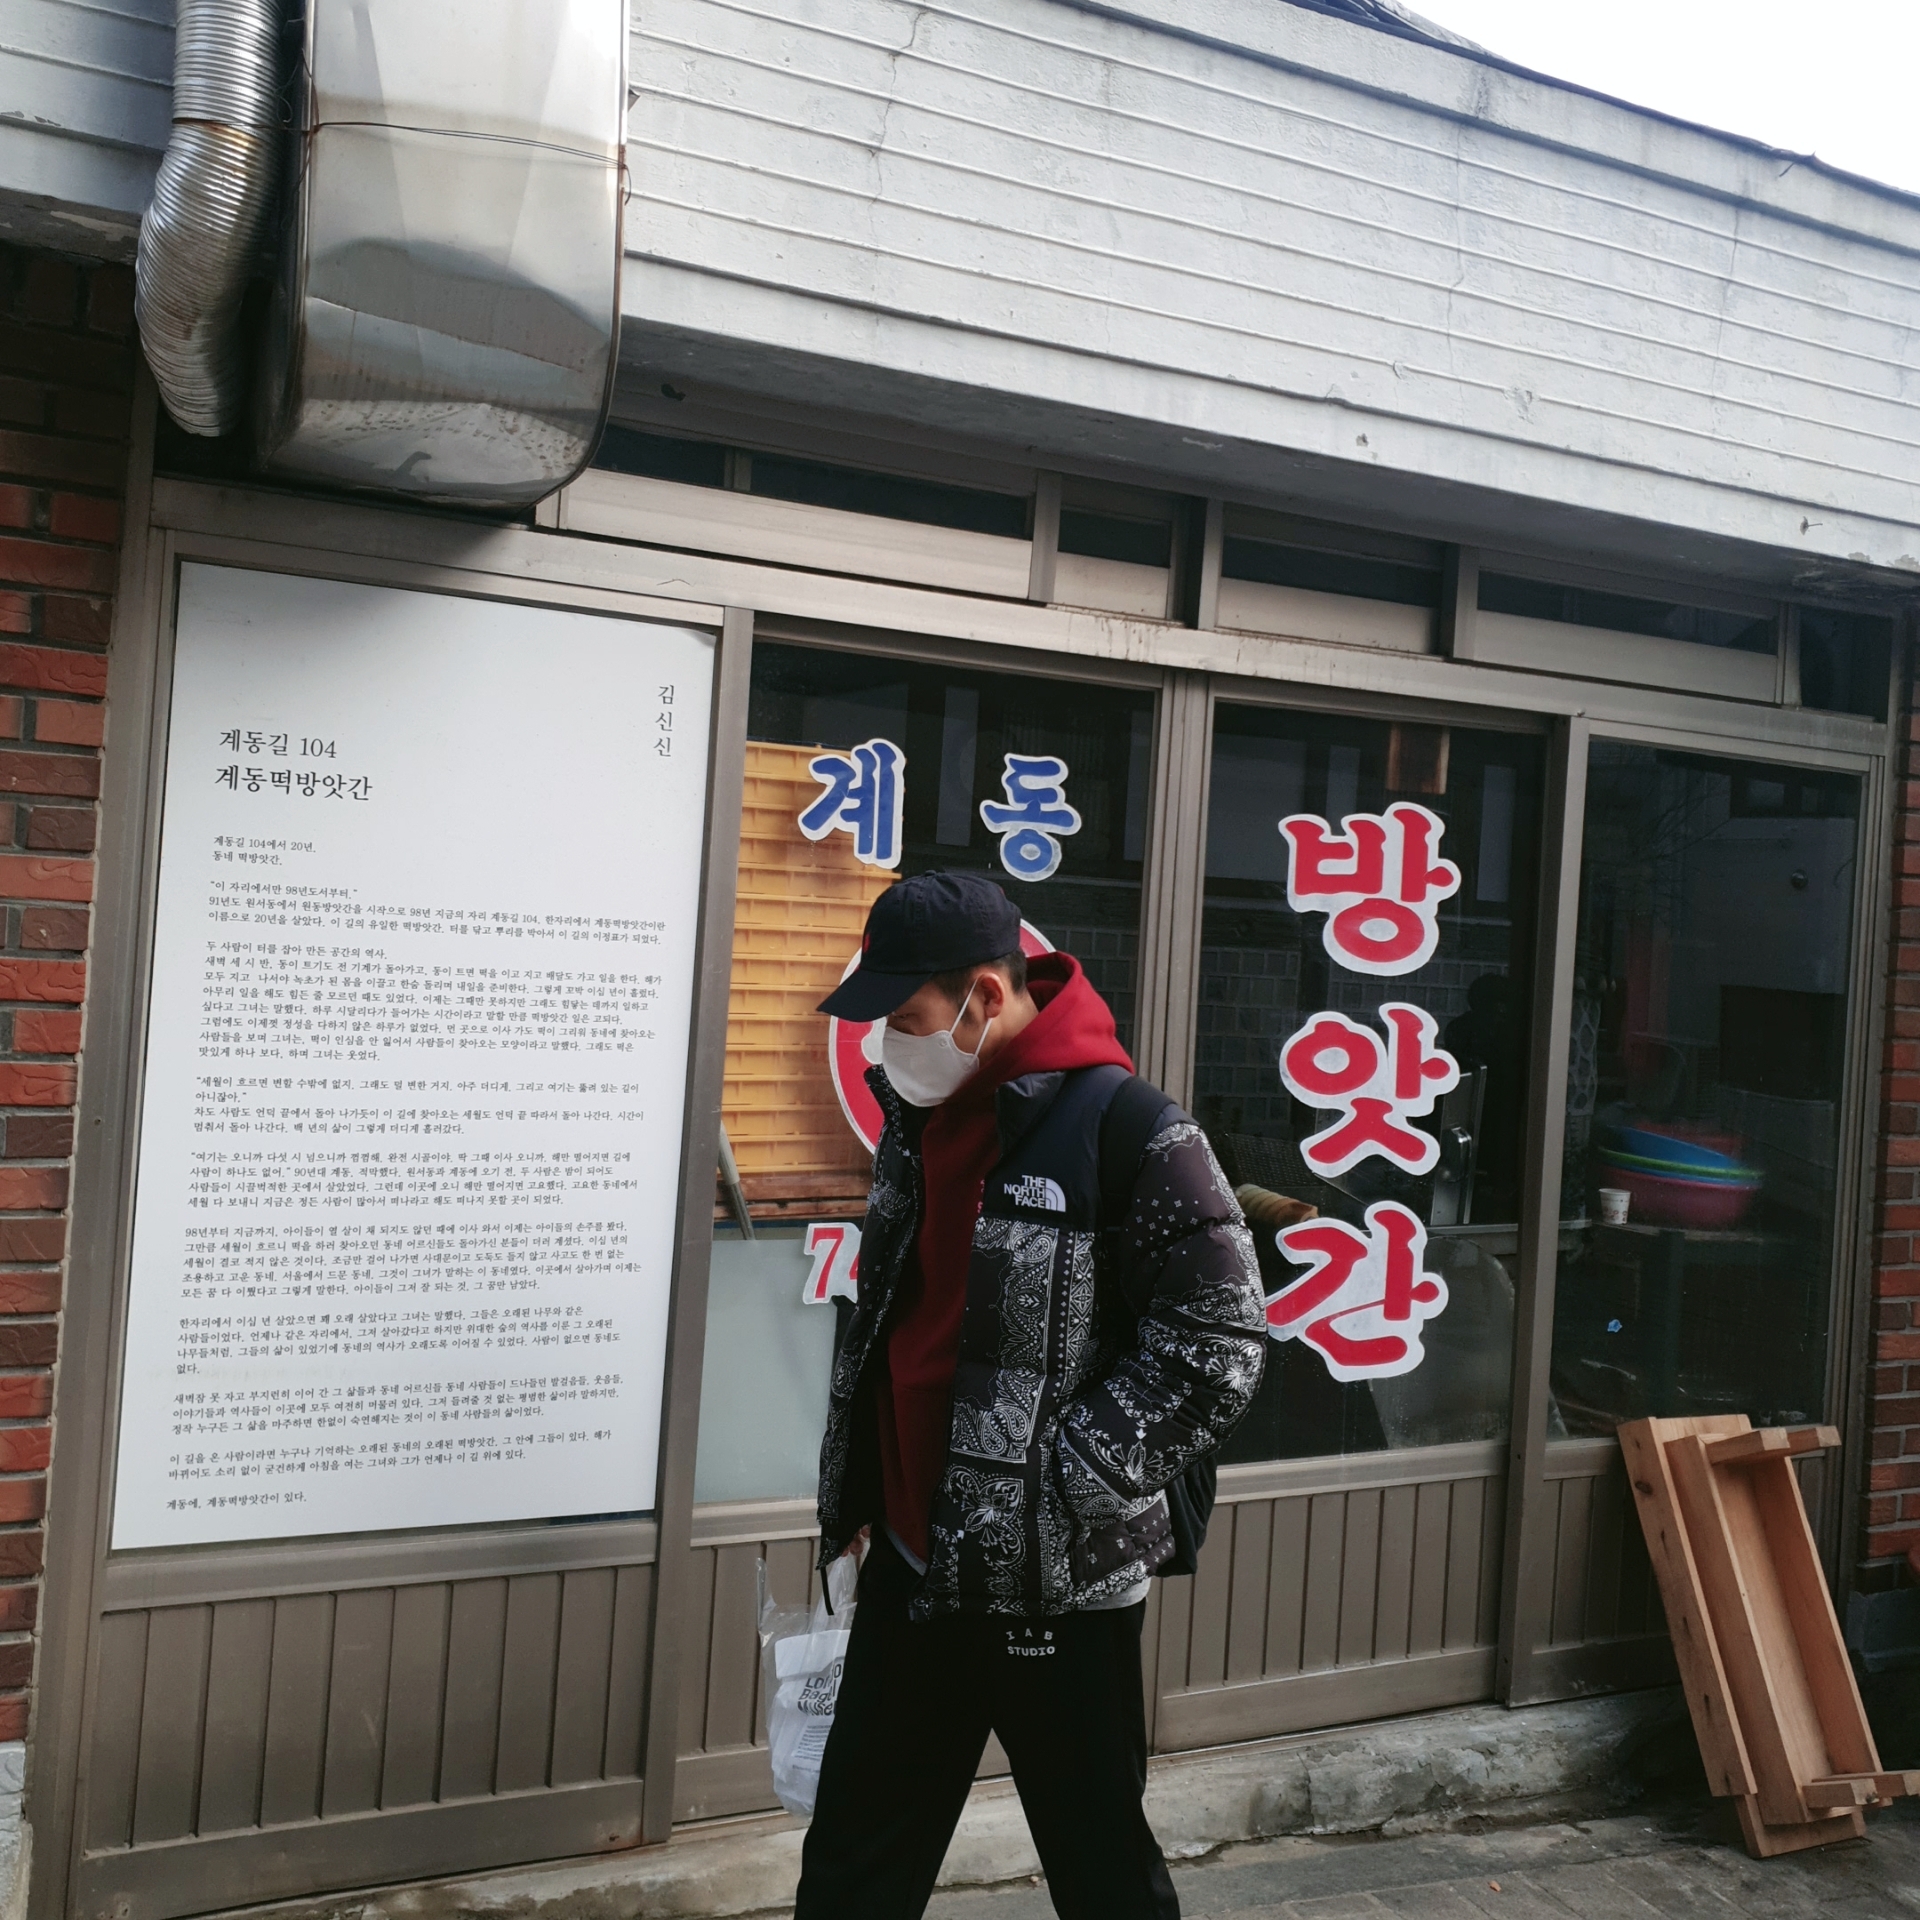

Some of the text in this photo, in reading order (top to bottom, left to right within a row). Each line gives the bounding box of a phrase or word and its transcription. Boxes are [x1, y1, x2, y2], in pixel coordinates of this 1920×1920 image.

[654, 685, 674, 757] 김신신
[220, 729, 336, 758] 계동길 104
[215, 765, 372, 800] 계동떡방앗간
[1267, 804, 1459, 1380] 방앗간
[1004, 1183, 1045, 1197] NORTH
[1022, 1175, 1046, 1187] THE
[1015, 1195, 1046, 1208] FACE
[1008, 1646, 1055, 1656] STUDIO
